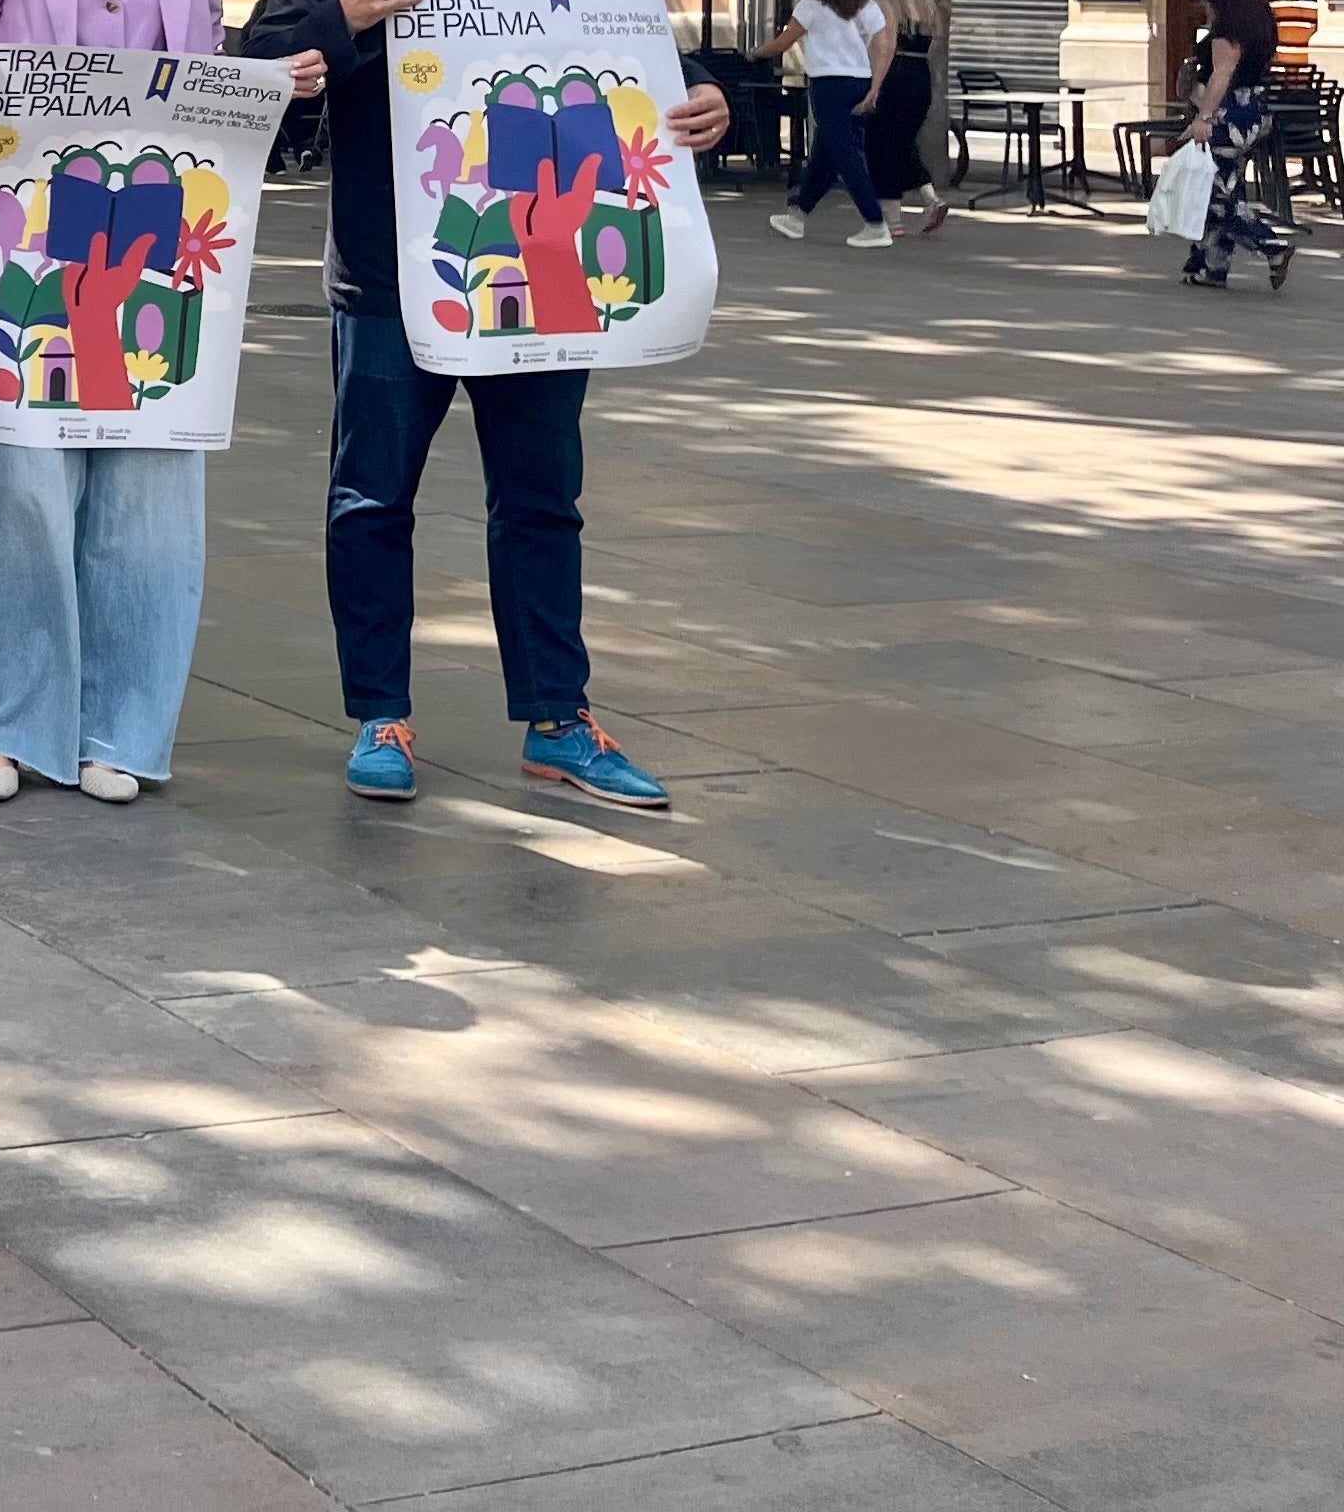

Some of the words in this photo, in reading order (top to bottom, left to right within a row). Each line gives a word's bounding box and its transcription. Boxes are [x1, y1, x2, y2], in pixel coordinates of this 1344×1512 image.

[394, 14, 436, 39] DE
[443, 11, 545, 37] PALMA
[581, 12, 598, 23] Del
[599, 12, 612, 23] 30
[614, 12, 627, 23] de
[583, 25, 590, 35] 8
[592, 24, 605, 35] de
[632, 24, 645, 35] de
[65, 52, 124, 75] DEL
[187, 60, 241, 82] Plaça
[402, 62, 438, 74] Edició
[413, 73, 428, 84] 43
[183, 78, 281, 103] d'Espanya
[29, 96, 131, 117] PALMA
[174, 103, 194, 113] Del
[195, 106, 211, 115] 30
[212, 108, 226, 117] de
[172, 113, 179, 121] 8
[181, 114, 195, 122] de
[226, 119, 241, 128] de
[243, 120, 271, 131] 2025
